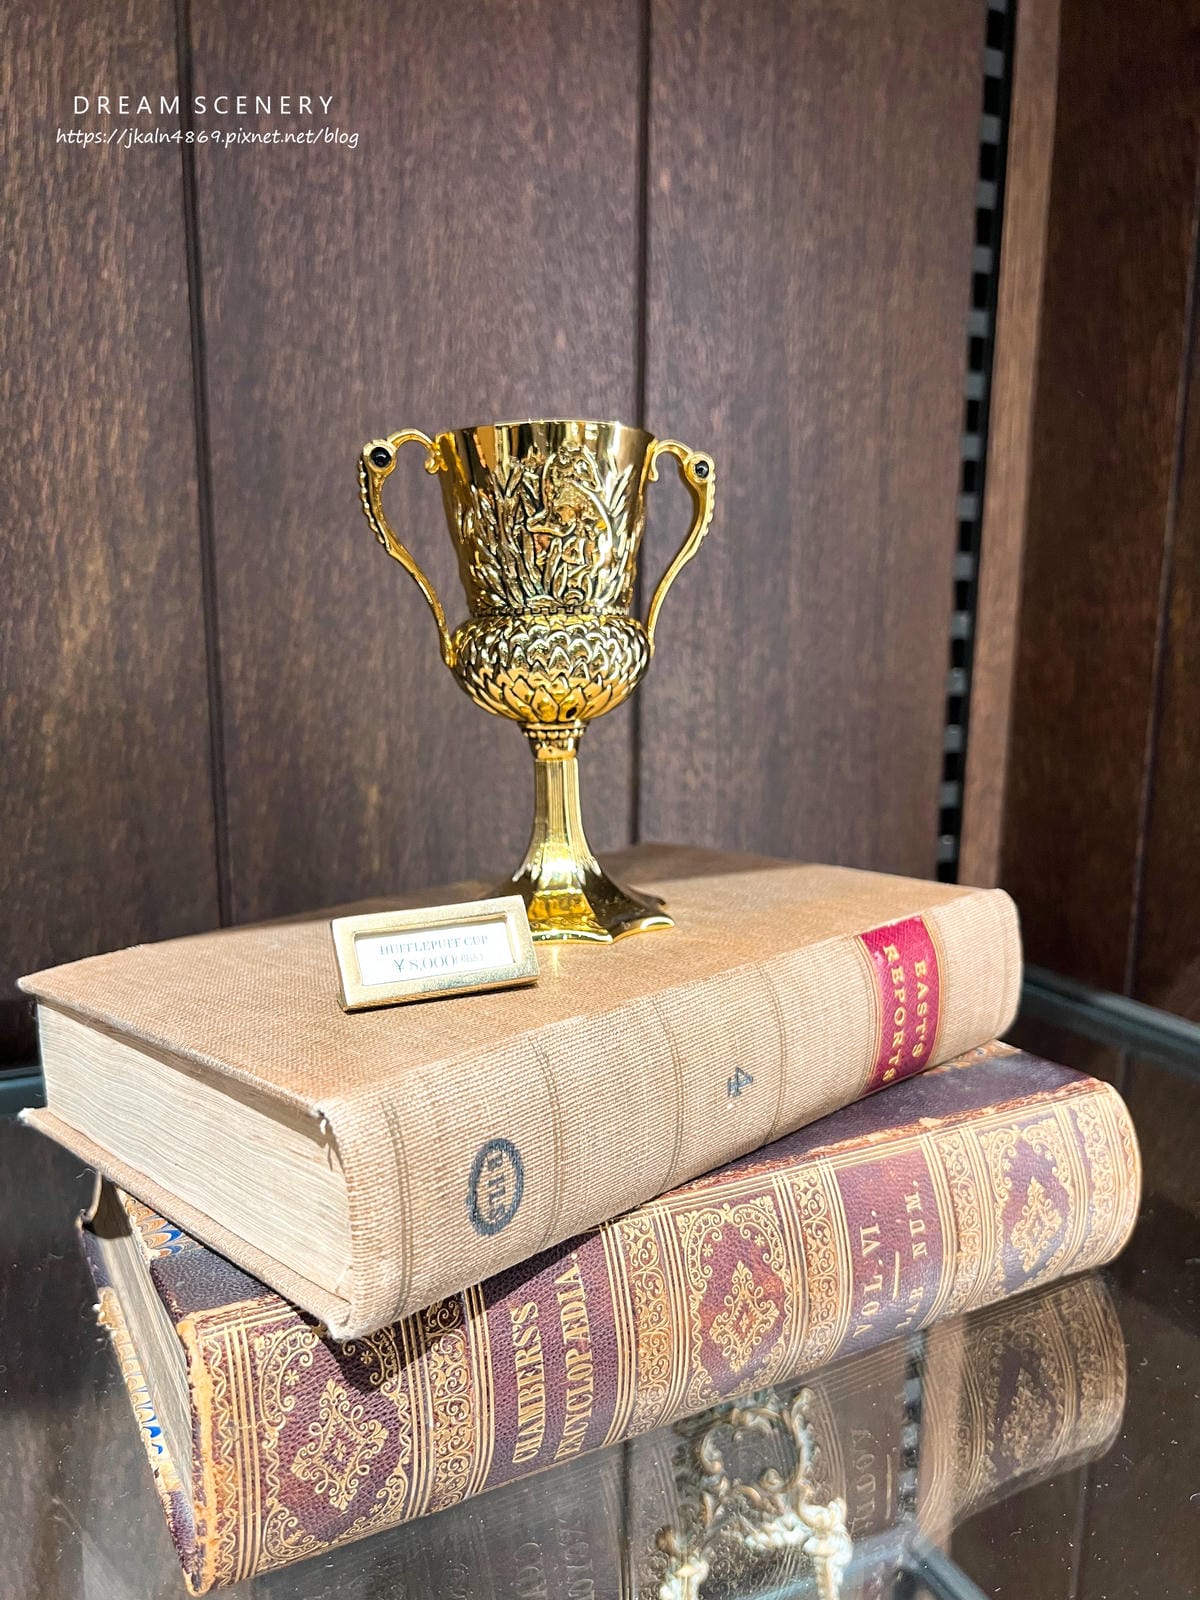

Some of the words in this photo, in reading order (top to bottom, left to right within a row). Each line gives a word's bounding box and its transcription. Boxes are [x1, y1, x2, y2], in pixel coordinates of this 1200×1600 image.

[380, 937, 461, 956] HUFFLEPUFF
[463, 935, 488, 947] CUP
[882, 943, 907, 1083] REPORTS
[911, 960, 929, 1058] EAST'S
[904, 1179, 928, 1260] NUM.
[510, 1301, 546, 1464] CHAMBERS'S
